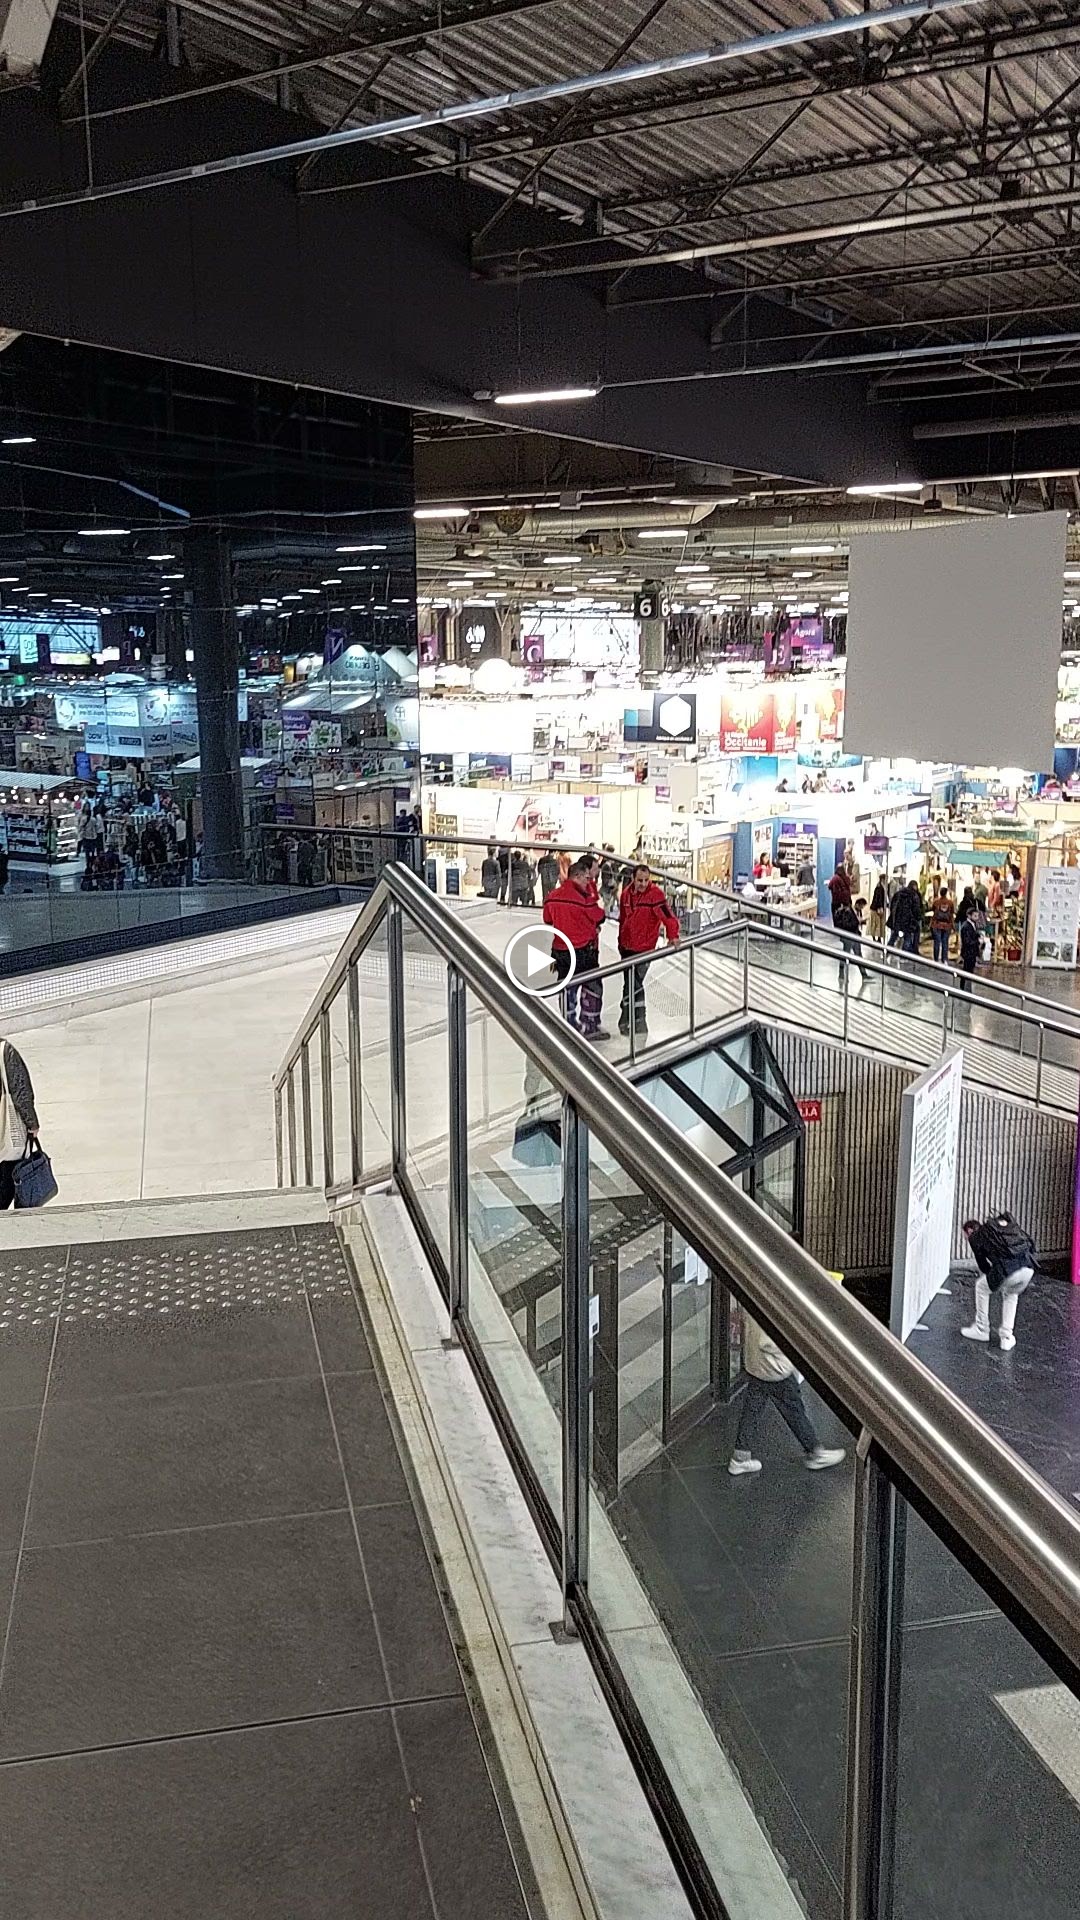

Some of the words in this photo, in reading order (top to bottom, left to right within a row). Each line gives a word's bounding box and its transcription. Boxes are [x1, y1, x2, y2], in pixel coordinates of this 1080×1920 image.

[639, 598, 652, 617] 6
[661, 598, 670, 617] 6
[725, 736, 767, 747] Occitanie
